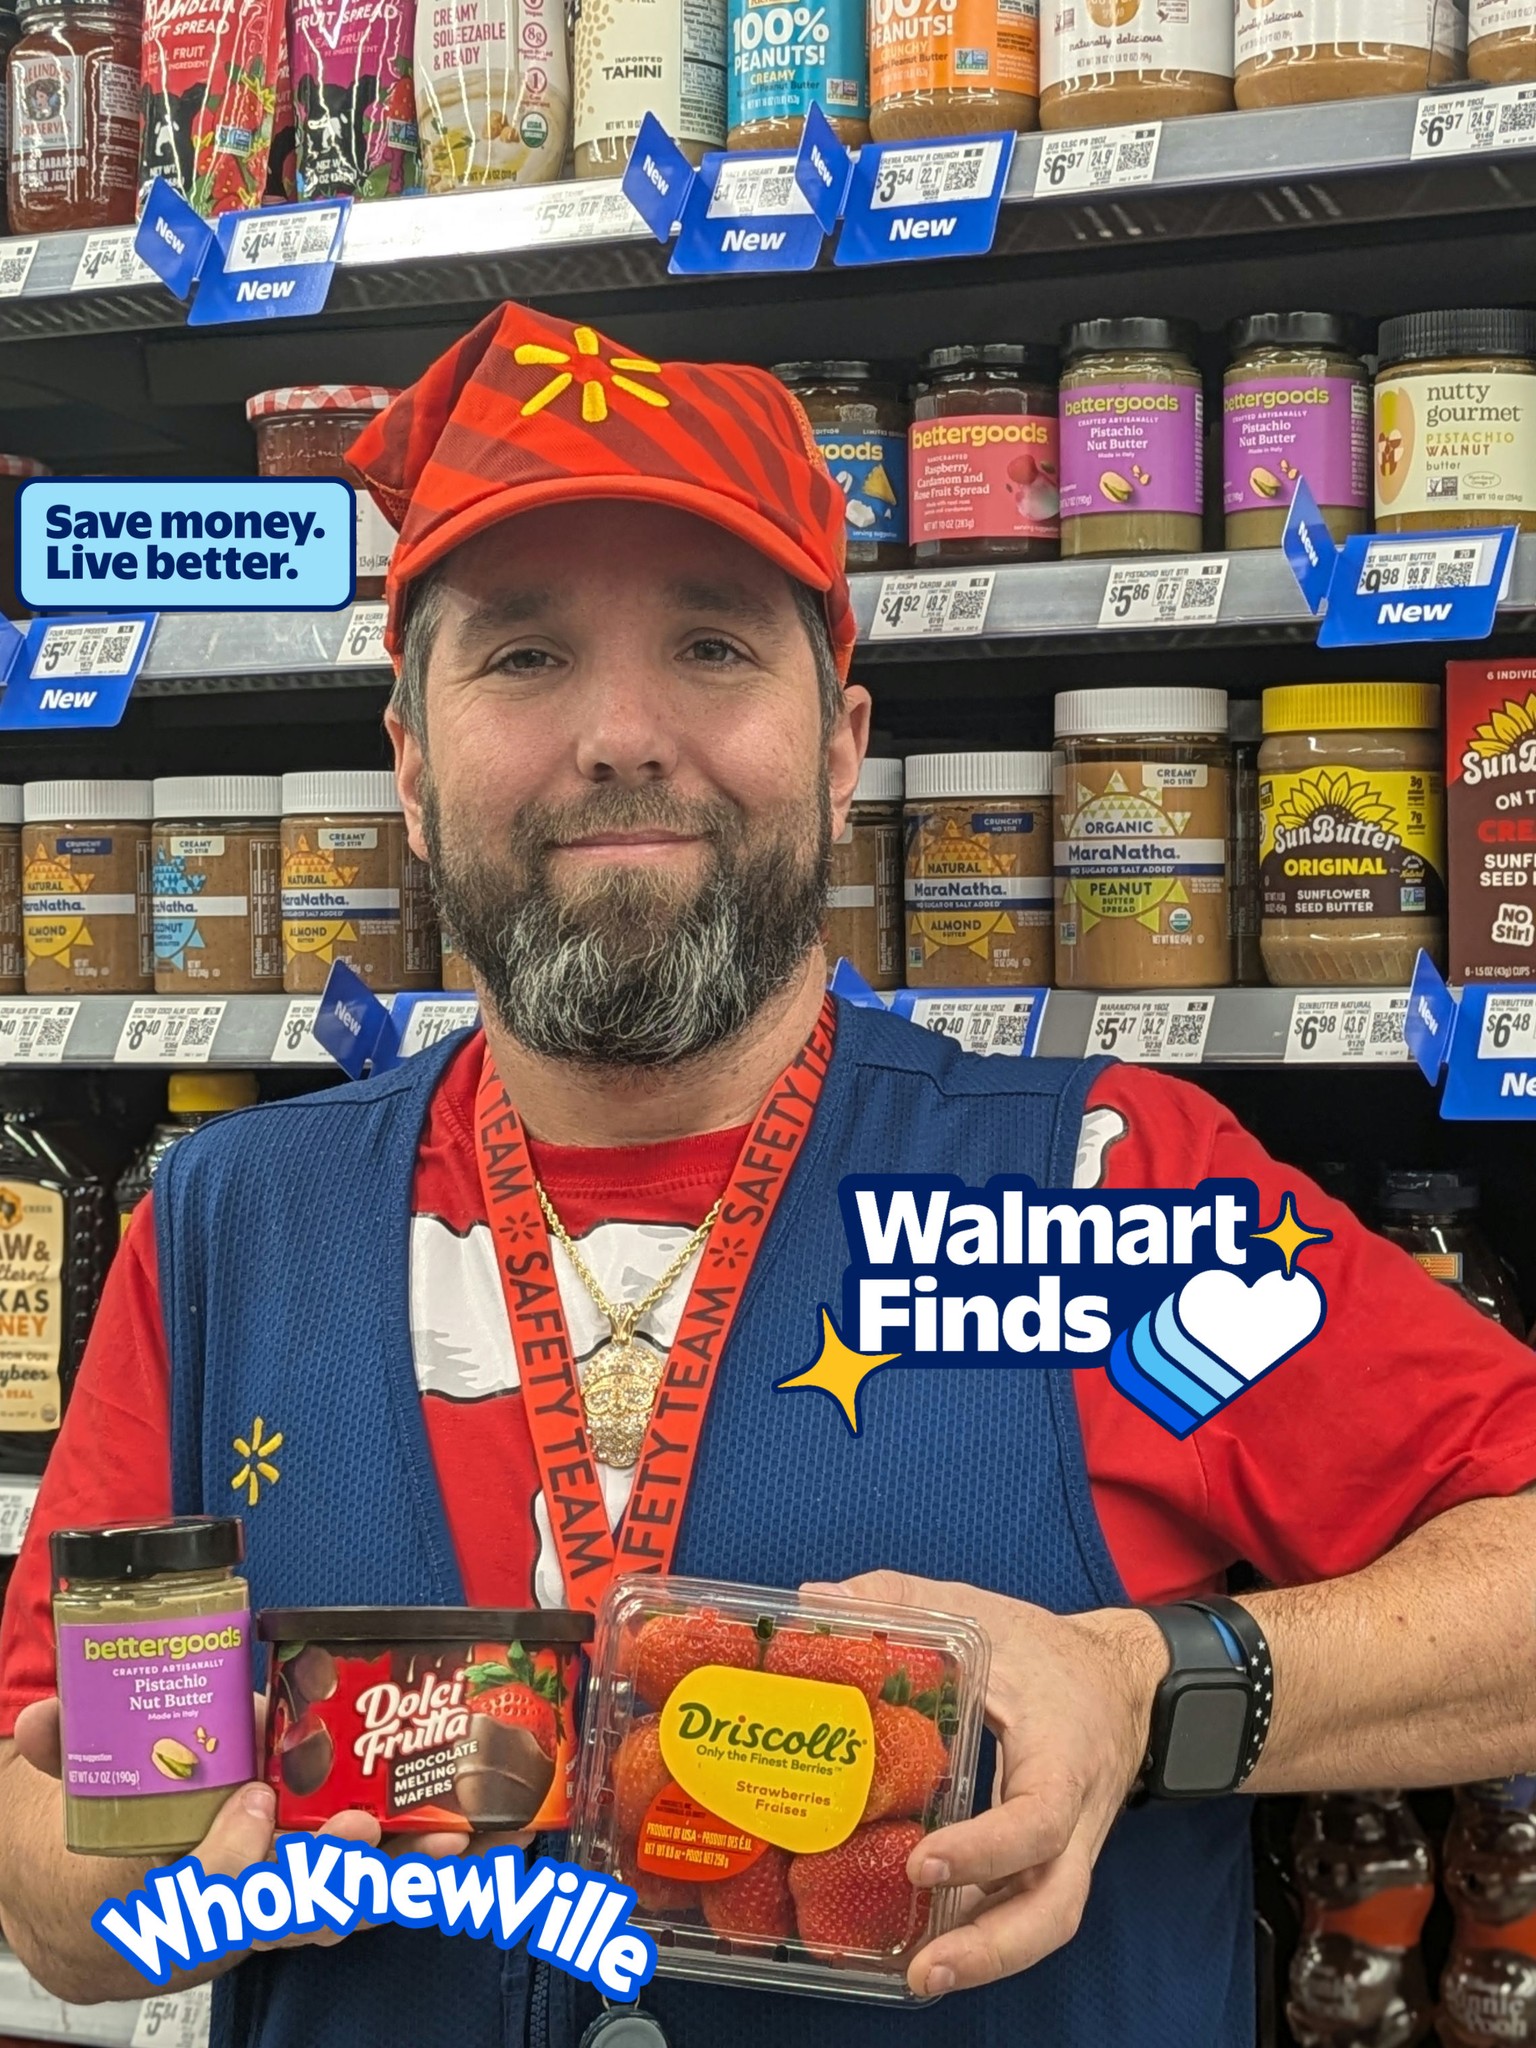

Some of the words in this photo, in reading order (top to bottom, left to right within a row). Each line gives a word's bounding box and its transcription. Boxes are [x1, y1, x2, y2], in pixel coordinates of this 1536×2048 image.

[433, 3, 478, 27] CREAMY
[433, 21, 506, 50] SQUEEZABLE
[527, 27, 544, 44] 8g
[733, 6, 829, 55] 100%
[871, 15, 954, 49] PEANUTS!
[1116, 32, 1163, 45] delicious
[172, 45, 204, 60] FRUIT
[433, 57, 442, 71] &
[443, 46, 481, 69] READY
[880, 40, 929, 60] CRUNCHY
[614, 56, 663, 64] IMPORTED
[734, 44, 826, 76] PEANUTS!
[889, 55, 918, 67] Peanut
[919, 52, 948, 62] Butter
[602, 65, 663, 81] TAHINI
[750, 69, 796, 86] CREAMY
[759, 82, 789, 93] Peanut
[790, 80, 820, 91] Butter
[931, 151, 960, 162] CRUNCH
[811, 144, 834, 188] New
[643, 154, 670, 196] New
[155, 216, 185, 255] New
[889, 217, 957, 242] New
[721, 230, 787, 252] New
[236, 279, 296, 303] New
[1224, 386, 1330, 413] bettergoods
[1426, 382, 1491, 403] nutty
[1064, 393, 1180, 417] bettergoods
[1078, 418, 1107, 427] CRAFTED
[1426, 404, 1521, 428] gourmet
[912, 421, 1048, 450] bettergoods
[1090, 426, 1144, 440] Pistachio
[1241, 419, 1292, 435] Pistachio
[1087, 439, 1108, 452] Nut
[1109, 437, 1149, 451] Butter
[1239, 434, 1258, 447] Nut
[1258, 431, 1297, 445] Butter
[1426, 432, 1515, 444] PISTACHIO
[1425, 444, 1490, 458] WALNUT
[924, 462, 972, 476] Raspberry,
[1426, 460, 1462, 472] butter
[917, 474, 961, 489] Cardamom
[962, 472, 983, 485] and
[929, 487, 952, 499] Fruit
[953, 484, 991, 499] Spread
[1462, 493, 1474, 501] NET
[1474, 493, 1486, 501] WT
[1488, 493, 1496, 501] 10
[1297, 520, 1319, 568] New
[1378, 554, 1408, 563] WALNUT
[1409, 552, 1437, 561] BUTTER
[1377, 602, 1453, 625] New
[1487, 670, 1496, 681] 6
[39, 689, 98, 710] New
[1156, 768, 1197, 778] CREAMY
[1163, 778, 1176, 786] NO
[1177, 777, 1194, 786] STIR
[1410, 775, 1423, 789] 3g
[1495, 790, 1524, 811] ON
[984, 818, 1023, 826] CRUNCHY
[1410, 811, 1423, 823] 7g
[1085, 820, 1154, 835] ORGANIC
[1273, 813, 1401, 854] SunButter
[179, 840, 213, 848] CREAMY
[329, 832, 366, 842] CREAMY
[1068, 842, 1181, 862] MaraNatha.
[927, 861, 983, 874] NATURAL
[1082, 866, 1106, 875] SUGAR
[1106, 866, 1119, 875] OR
[1120, 865, 1140, 874] SALT
[1283, 857, 1388, 877] ORIGINAL
[27, 881, 65, 893] NATURAL
[287, 874, 327, 886] NATURAL
[1479, 870, 1528, 887] SEED
[914, 882, 1008, 897] MaraNatha.
[1090, 881, 1153, 897] PEANUT
[1296, 888, 1371, 900] SUNFLOWER
[955, 900, 971, 908] SALT
[1101, 905, 1136, 915] SPREAD
[1102, 897, 1136, 906] BUTTER
[1294, 901, 1323, 914] SEED
[1325, 901, 1374, 914] BUTTER
[1502, 908, 1529, 924] NO
[289, 926, 328, 938] ALMOND
[930, 919, 982, 932] ALMOND
[1495, 923, 1532, 943] Stir!
[942, 930, 967, 939] BUTTER
[1484, 966, 1493, 977] OZ
[1493, 965, 1512, 979] (43g)
[1512, 965, 1531, 977] CUPS
[1298, 1001, 1339, 1010] SUNBUTTER
[1340, 1001, 1372, 1009] NATURAL
[1491, 998, 1534, 1008] SUNBUTTER
[334, 1000, 362, 1037] New
[1418, 995, 1440, 1038] New
[478, 1085, 534, 1206] TEAM
[722, 1082, 813, 1230] SAFETY
[33, 1239, 51, 1263] &
[504, 1250, 581, 1420] SAFETY
[655, 1285, 737, 1421] TEAM
[542, 1425, 615, 1582] TEAM
[83, 1624, 242, 1662] bettergoods
[112, 1666, 159, 1678] CRAFTED
[161, 1658, 224, 1673] ARTISANALLY
[134, 1673, 208, 1694] Pistachio
[129, 1695, 160, 1712] Nut
[164, 1689, 215, 1710] Butter
[355, 1671, 468, 1730] Dolci
[147, 1711, 172, 1722] Made
[172, 1710, 181, 1719] in
[181, 1708, 199, 1720] Italy
[353, 1704, 472, 1777] Frutta
[677, 1700, 863, 1767] Driscoll's
[394, 1740, 479, 1777] CHOCOLATE
[696, 1743, 725, 1763] Only
[726, 1748, 748, 1764] the
[750, 1751, 788, 1770] Finest
[88, 1770, 100, 1783] 6.7
[100, 1770, 111, 1782] OZ
[111, 1769, 140, 1787] (190g)
[394, 1763, 457, 1793] MELTING
[392, 1778, 454, 1809] WAFERS
[735, 1779, 832, 1807] Strawberries
[754, 1797, 808, 1819] Fraises
[681, 1828, 697, 1842] USA
